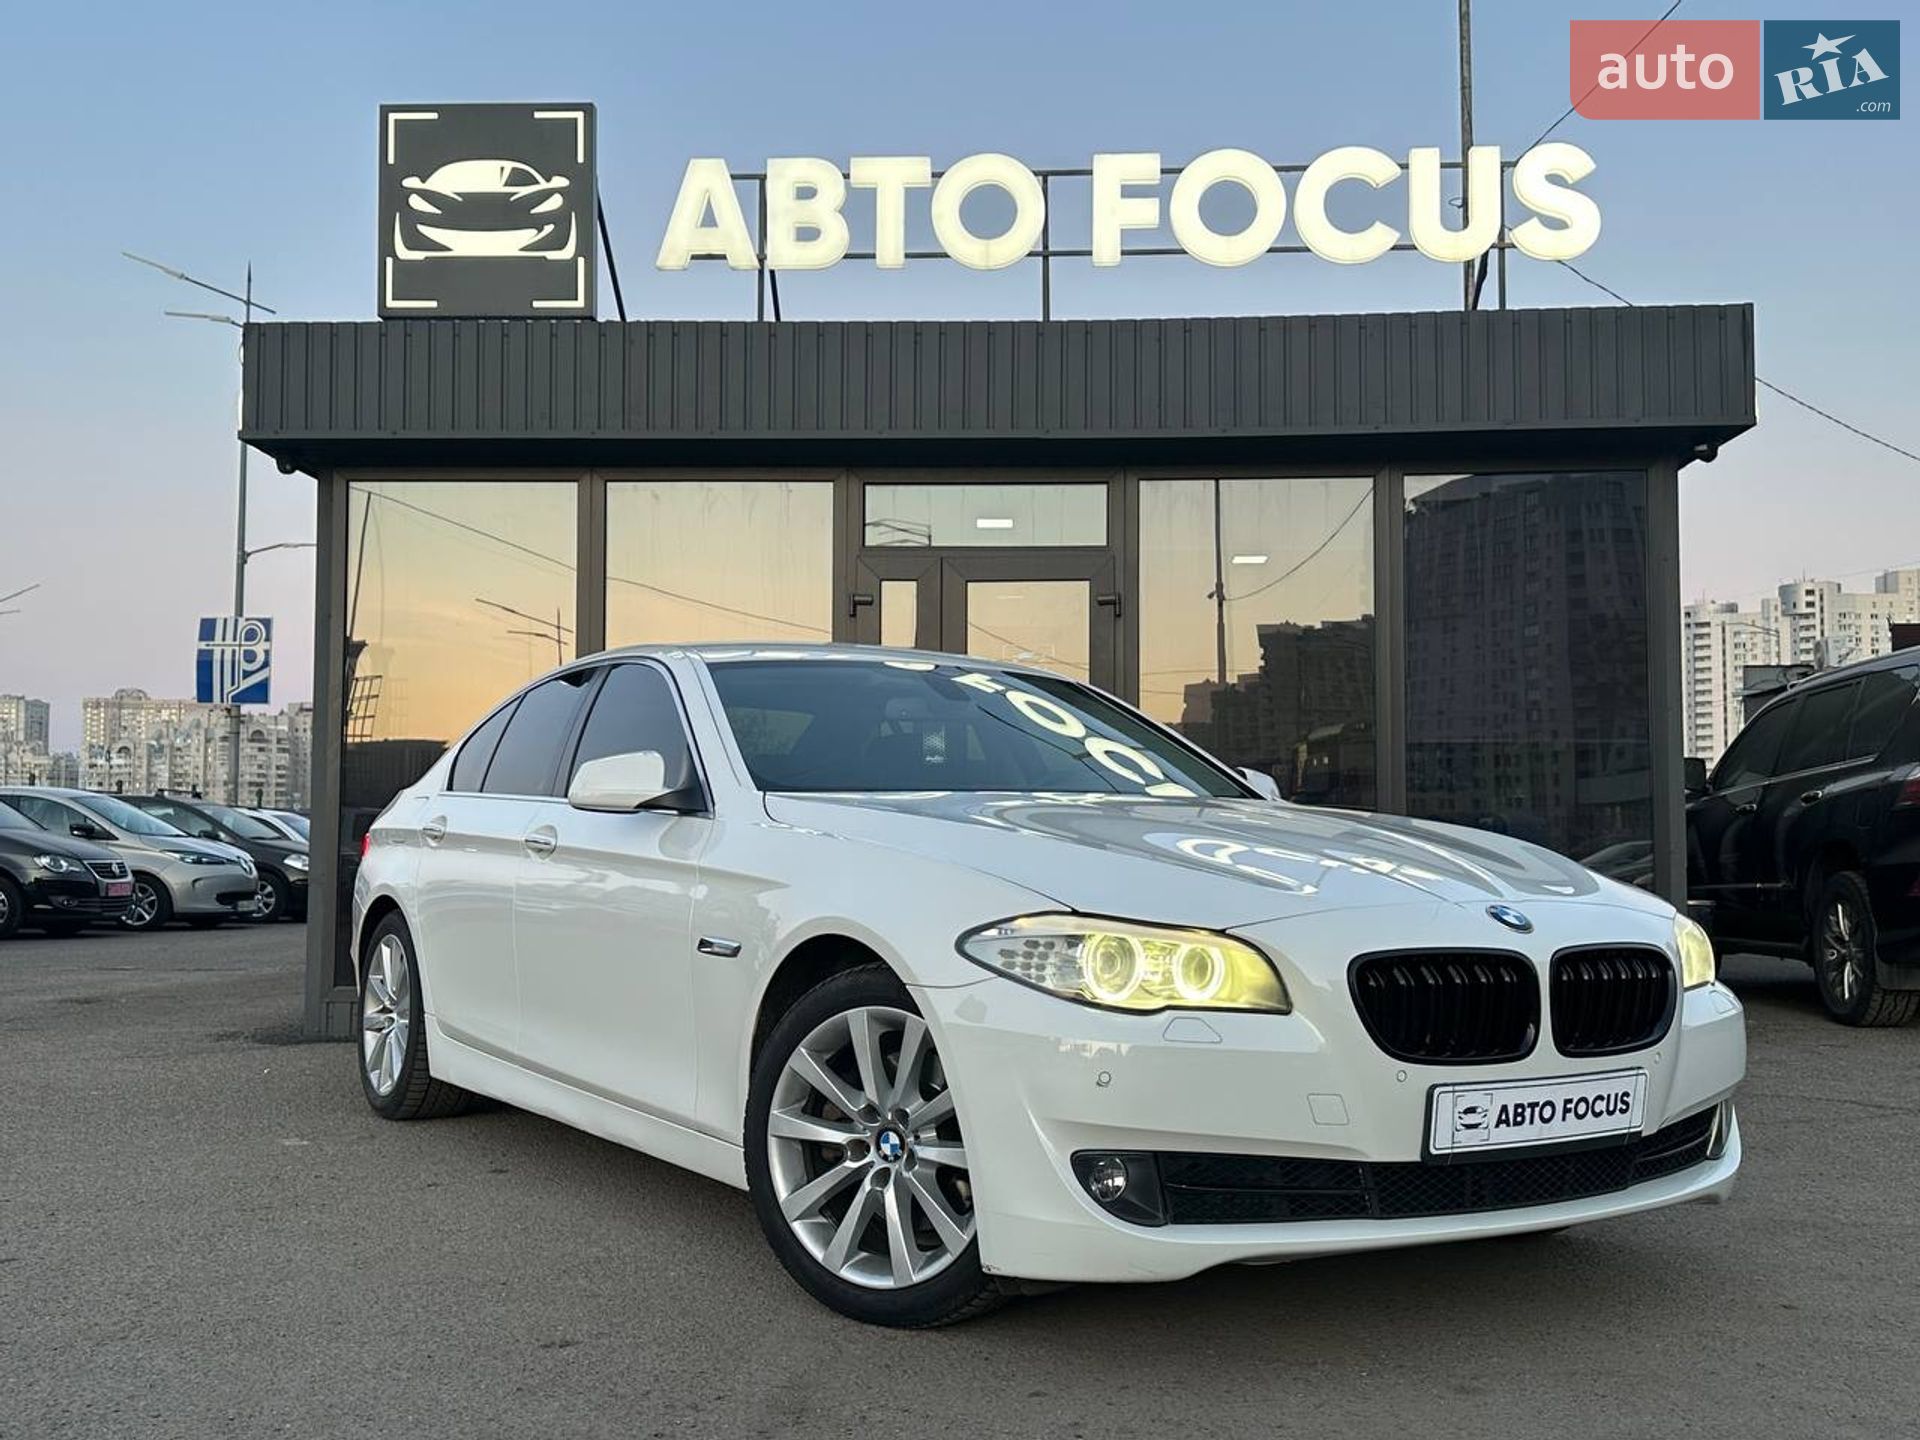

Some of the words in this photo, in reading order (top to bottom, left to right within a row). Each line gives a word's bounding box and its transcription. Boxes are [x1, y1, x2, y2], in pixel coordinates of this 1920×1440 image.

[655, 152, 1047, 271] АВТО
[1092, 142, 1601, 267] FOCUS
[1494, 1100, 1556, 1129] АВТО
[1561, 1091, 1631, 1122] FOCUS
